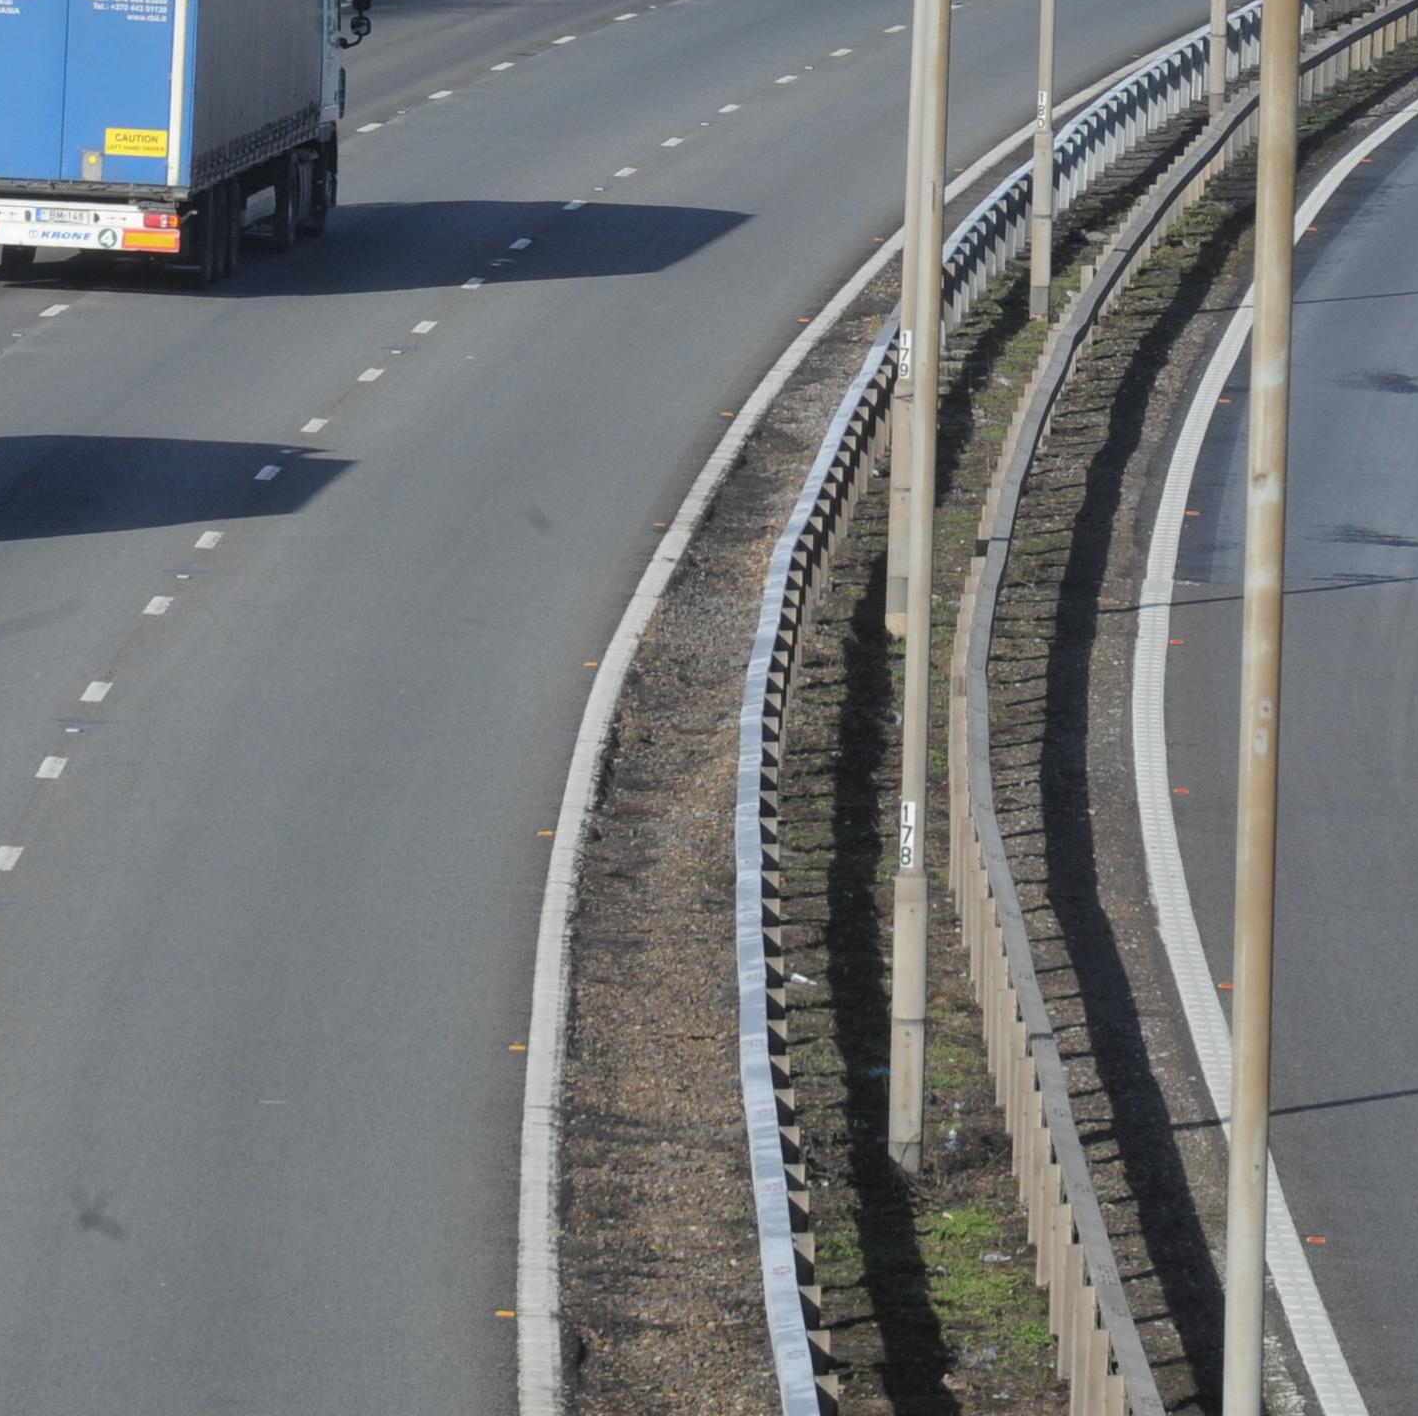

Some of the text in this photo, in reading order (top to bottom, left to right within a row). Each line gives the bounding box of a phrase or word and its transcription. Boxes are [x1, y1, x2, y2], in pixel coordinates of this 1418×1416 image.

[115, 133, 159, 144] CAUTION
[41, 230, 92, 241] KRONE
[900, 332, 909, 377] 179
[901, 803, 912, 865] 178
